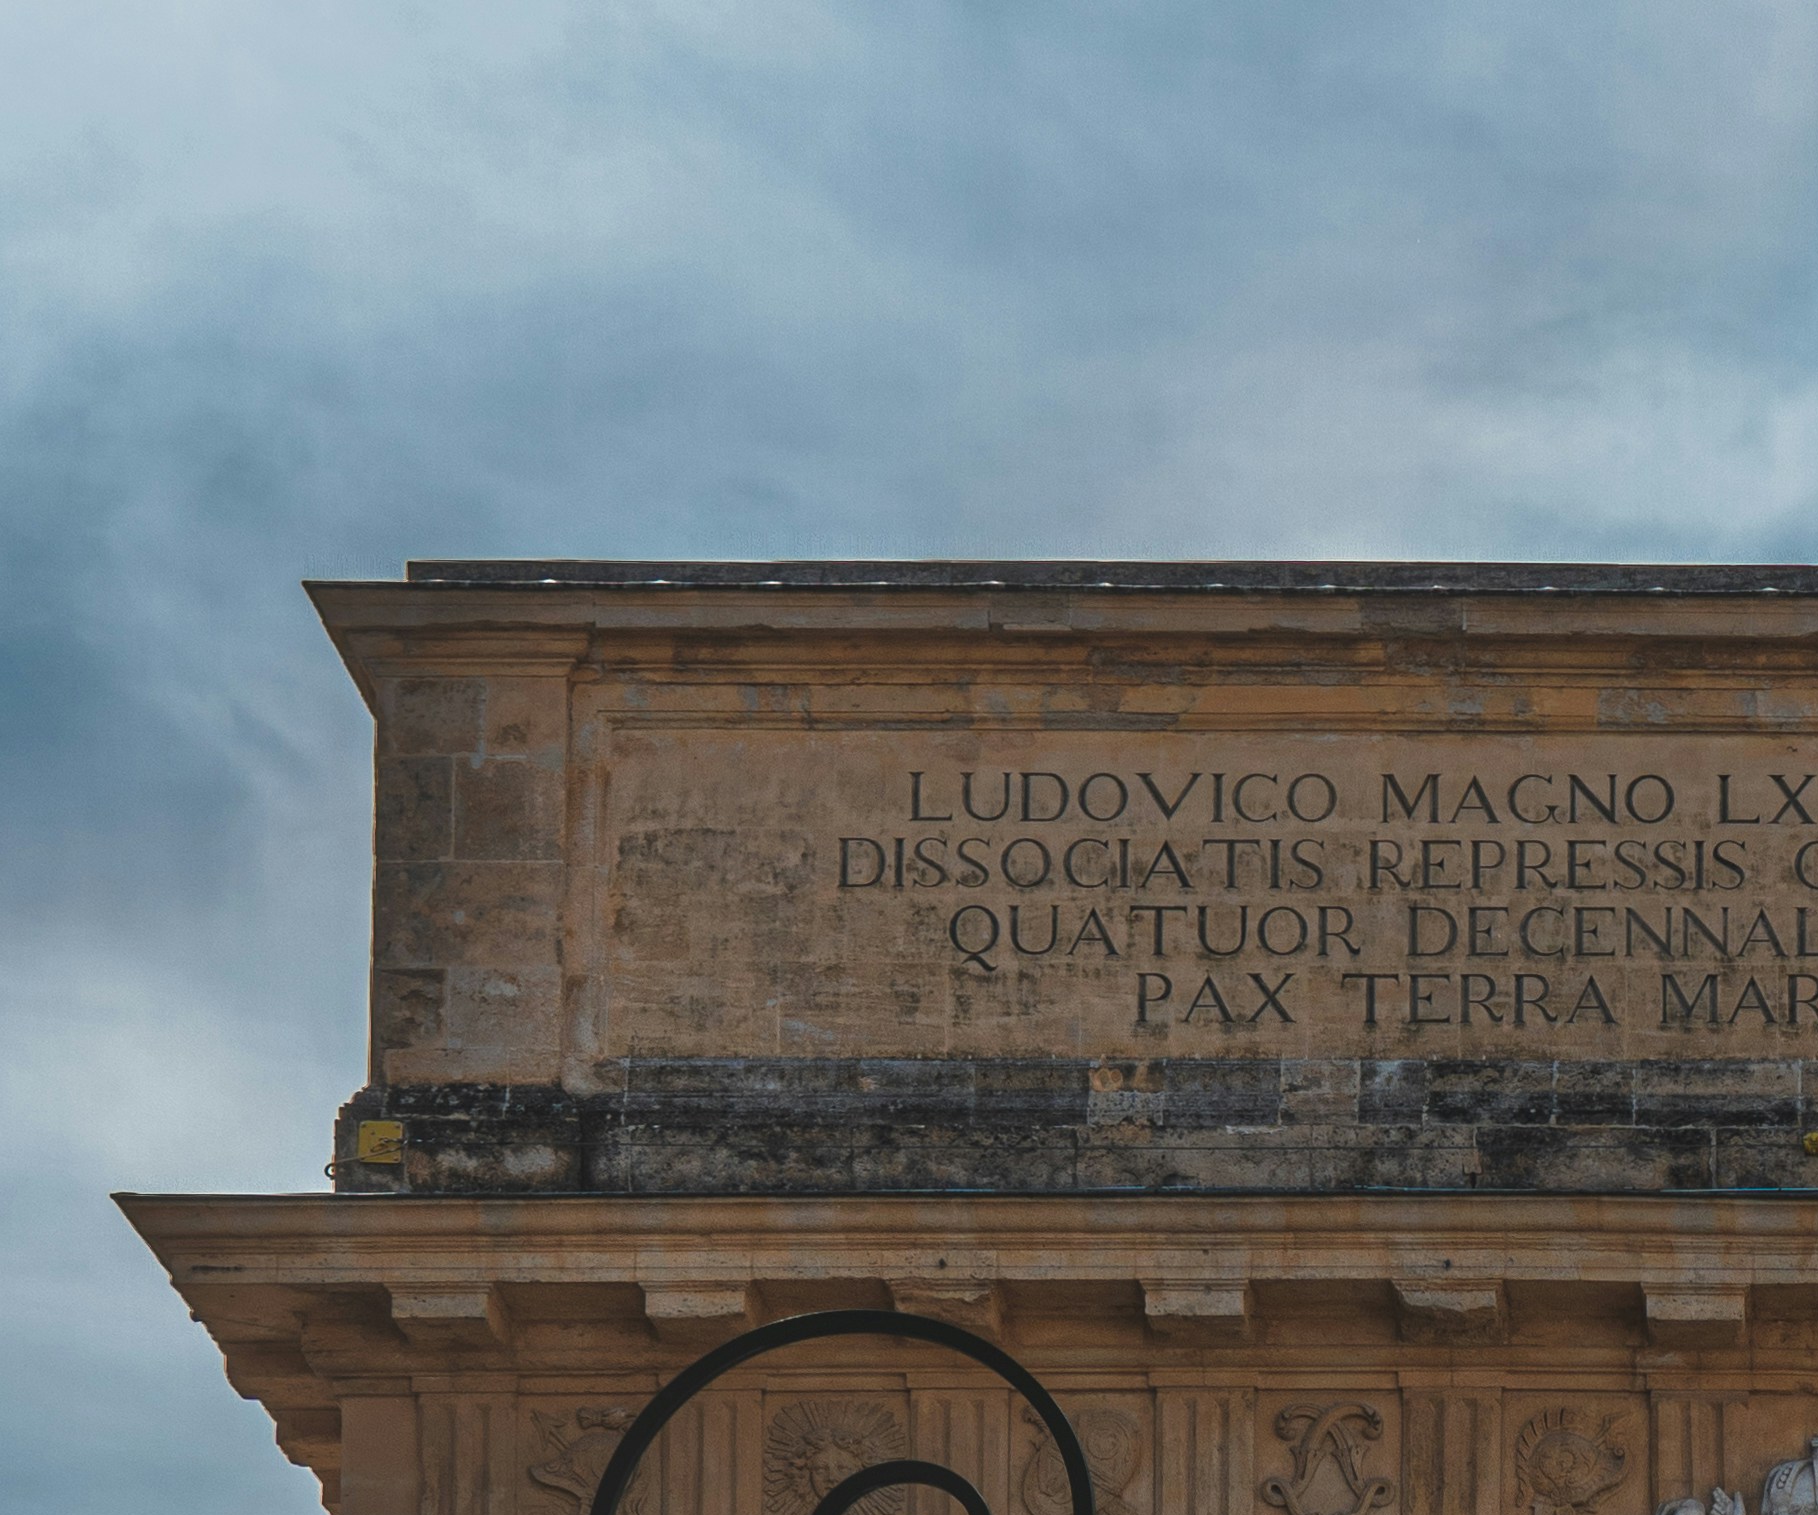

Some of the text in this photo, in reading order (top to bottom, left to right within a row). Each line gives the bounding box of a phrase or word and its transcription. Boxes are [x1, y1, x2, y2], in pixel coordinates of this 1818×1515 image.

[908, 771, 1338, 823] LUDOVICO
[1380, 773, 1675, 825] MAGNO
[837, 837, 1325, 889] DISSOCIATIS
[1368, 839, 1746, 890] REPRESSIS
[948, 905, 1361, 972] QUATUOR
[1135, 973, 1297, 1023] PAX
[1341, 973, 1622, 1025] TERRA
